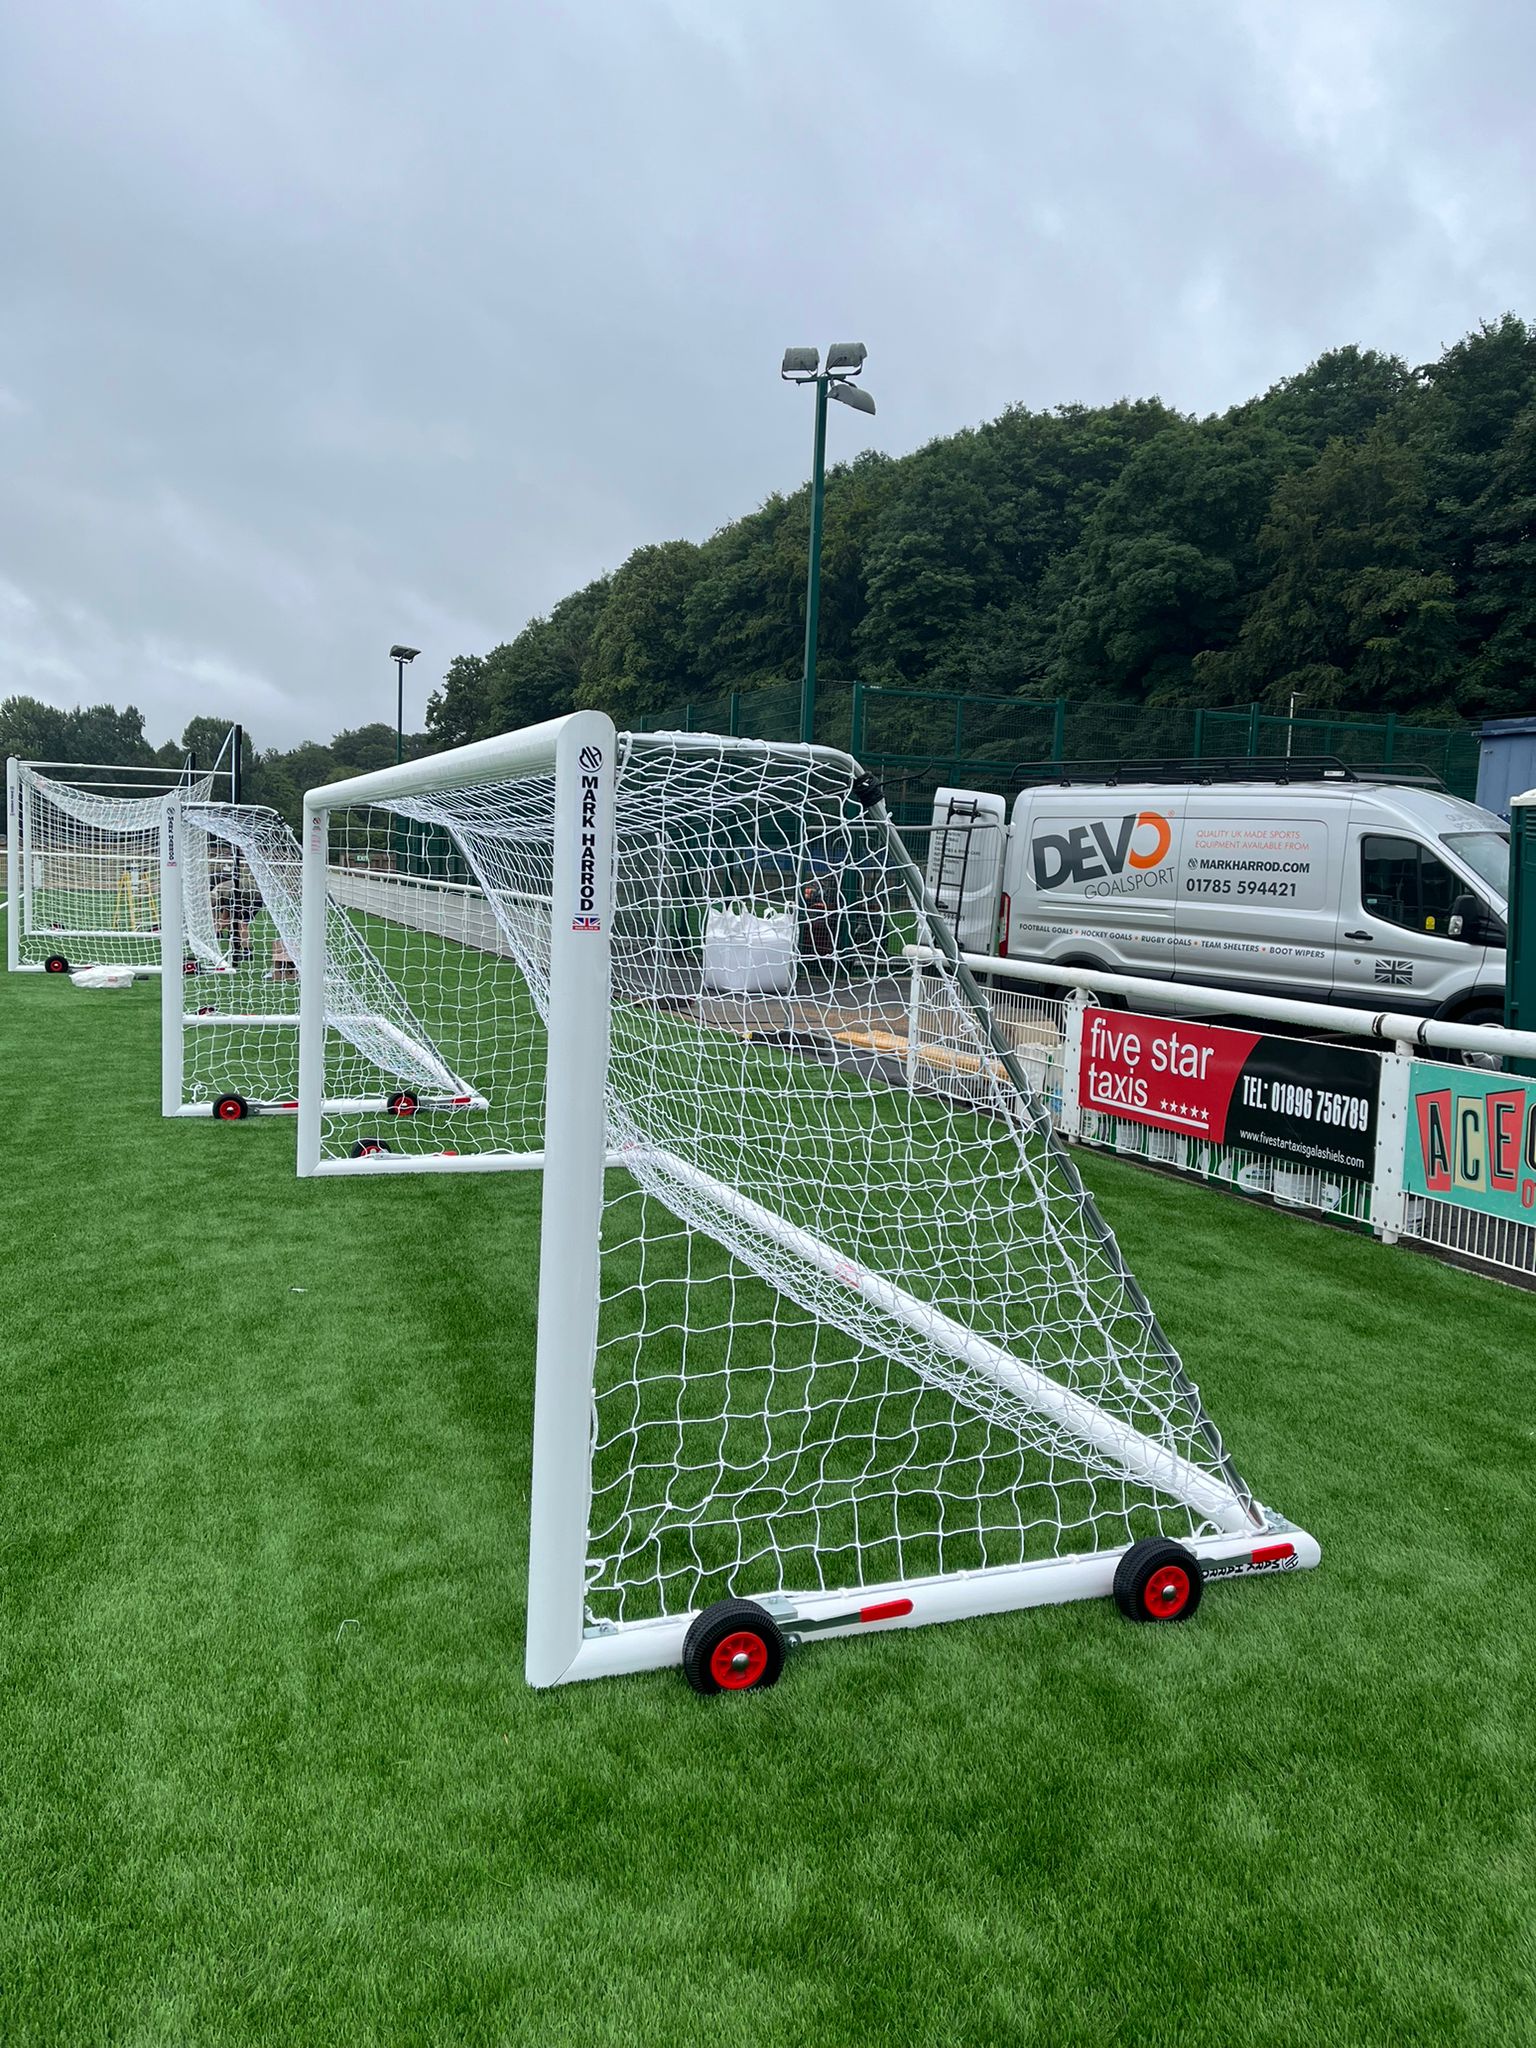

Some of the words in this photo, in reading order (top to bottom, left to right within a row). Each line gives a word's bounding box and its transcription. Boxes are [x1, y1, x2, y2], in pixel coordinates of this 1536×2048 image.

[581, 775, 598, 828] MARK
[1032, 811, 1171, 891] DEVO
[1195, 840, 1240, 849] EQUIPMENT
[1241, 841, 1281, 850] AVAILABLE
[1284, 842, 1309, 850] FROM
[1196, 830, 1229, 838] QUALITY
[1269, 831, 1301, 839] SPORTS
[580, 833, 596, 911] HARROD
[1084, 866, 1175, 899] GOALSPORT
[1199, 858, 1311, 874] MARKHARROD.COM
[1186, 878, 1231, 894] 01785
[1236, 881, 1296, 897] 594421
[1019, 923, 1050, 933] FOOTBALL
[1051, 926, 1073, 935] GOALS
[1080, 929, 1109, 939] HOCKEY
[1109, 932, 1133, 941] GOALS
[1141, 935, 1166, 944] RUGBY
[1166, 937, 1192, 947] GOALS
[1201, 940, 1221, 949] TEAM
[1222, 942, 1260, 952] SHELTERS
[1269, 946, 1293, 955] BOOT
[1294, 949, 1325, 959] WIPERS
[1090, 1016, 1141, 1066] five
[1151, 1031, 1215, 1080] star
[1088, 1062, 1148, 1107] taxis
[1242, 1074, 1269, 1110] TEL:
[1271, 1081, 1313, 1119] 01896
[1315, 1090, 1369, 1132] 756789
[1239, 1128, 1365, 1169] www.fivestartaxisgalashiels.com
[1427, 1100, 1536, 1183] ACE
[1202, 1564, 1244, 1579] HARRO
